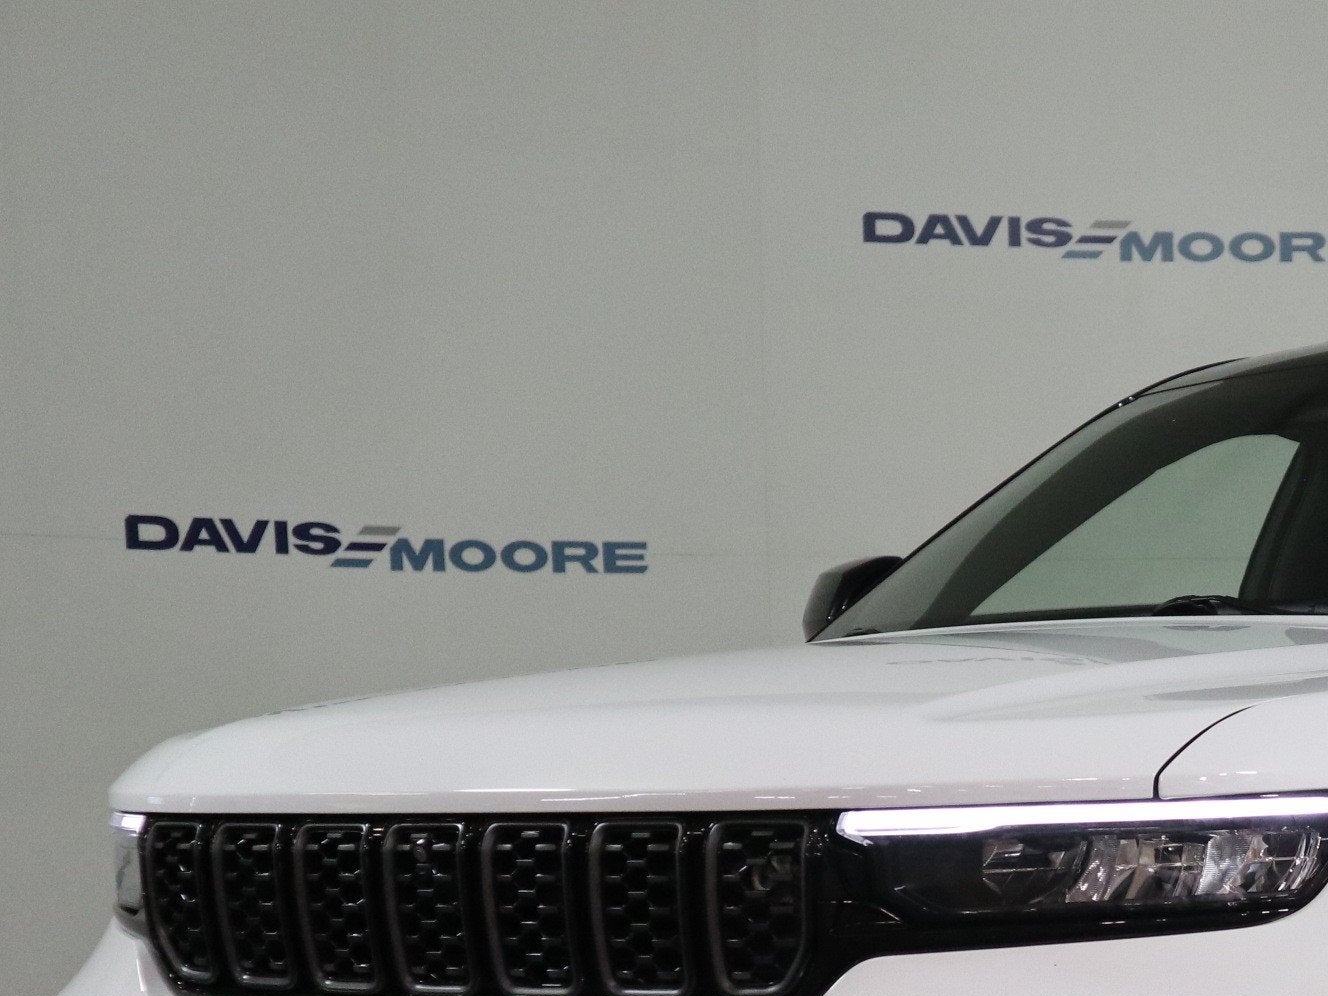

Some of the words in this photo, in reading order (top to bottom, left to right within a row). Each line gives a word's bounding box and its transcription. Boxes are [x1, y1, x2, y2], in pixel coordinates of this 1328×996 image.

[862, 211, 1073, 248] DAVIS
[124, 514, 342, 556] DAVIS
[389, 537, 648, 574] MOORE
